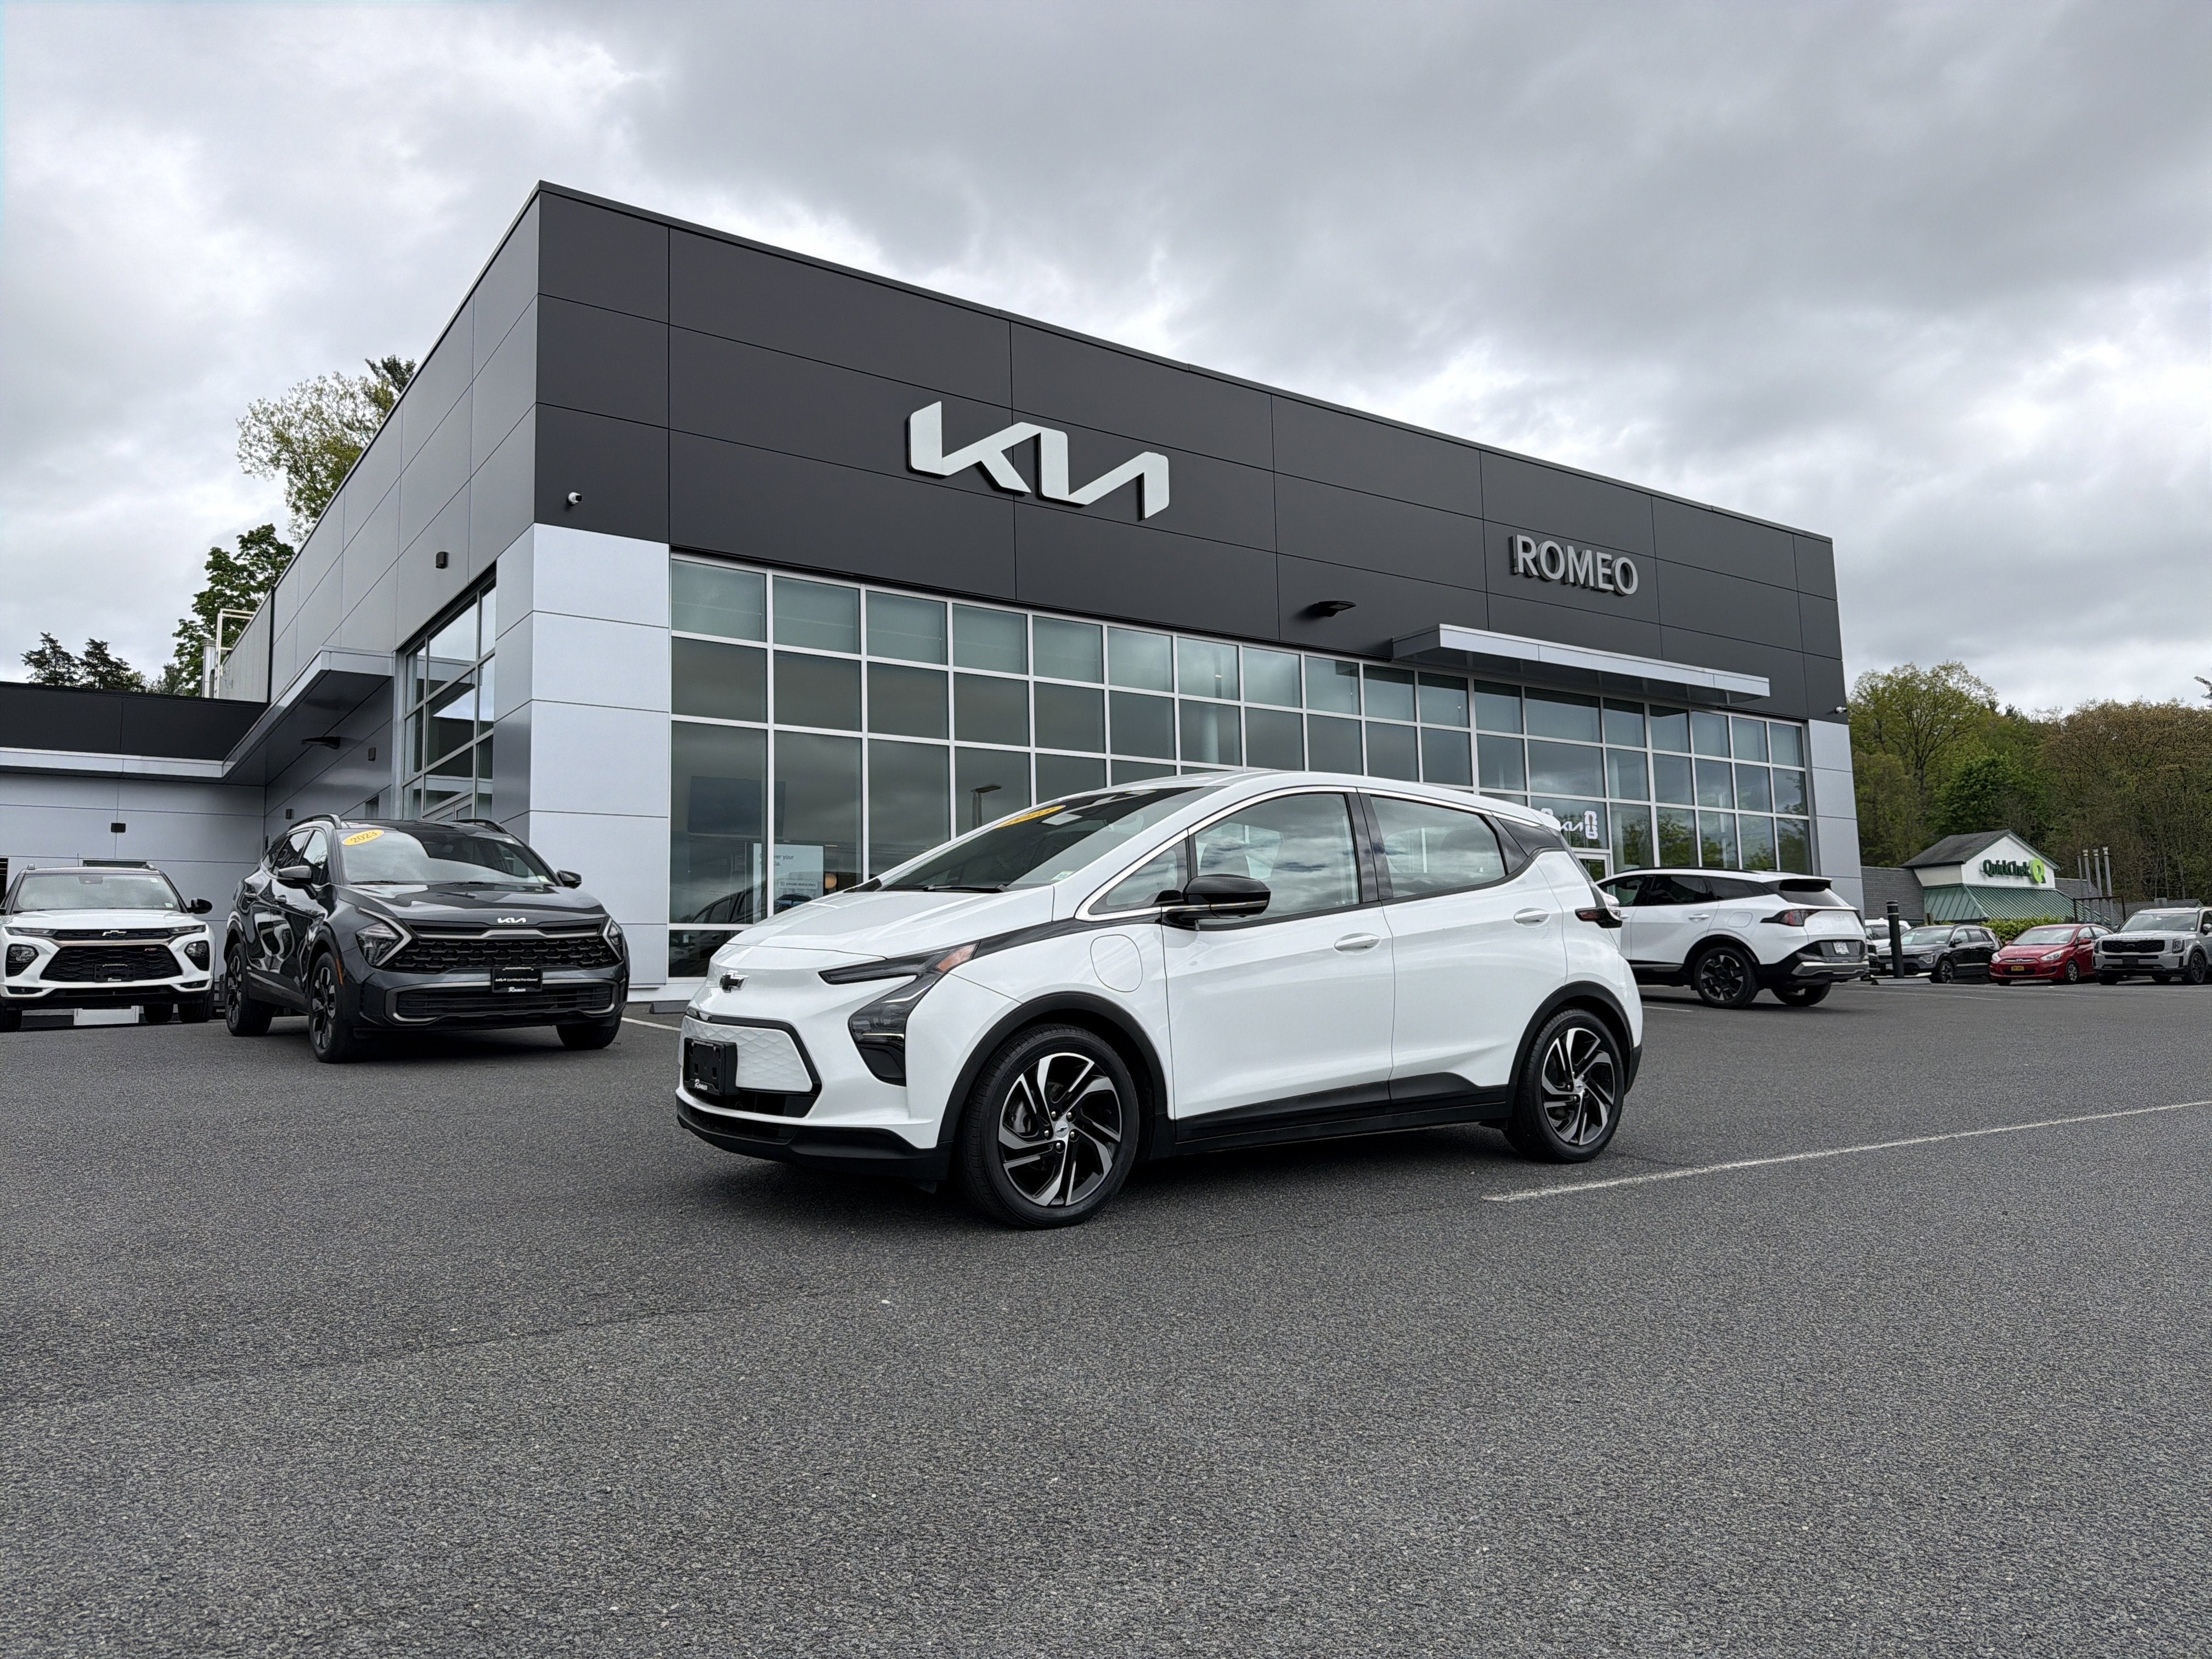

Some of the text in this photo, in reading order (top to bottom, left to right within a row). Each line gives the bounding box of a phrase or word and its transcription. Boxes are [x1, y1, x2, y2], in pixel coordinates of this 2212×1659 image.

[908, 400, 1170, 519] KIA
[1513, 534, 1638, 595] ROMEO
[350, 831, 377, 843] 2023
